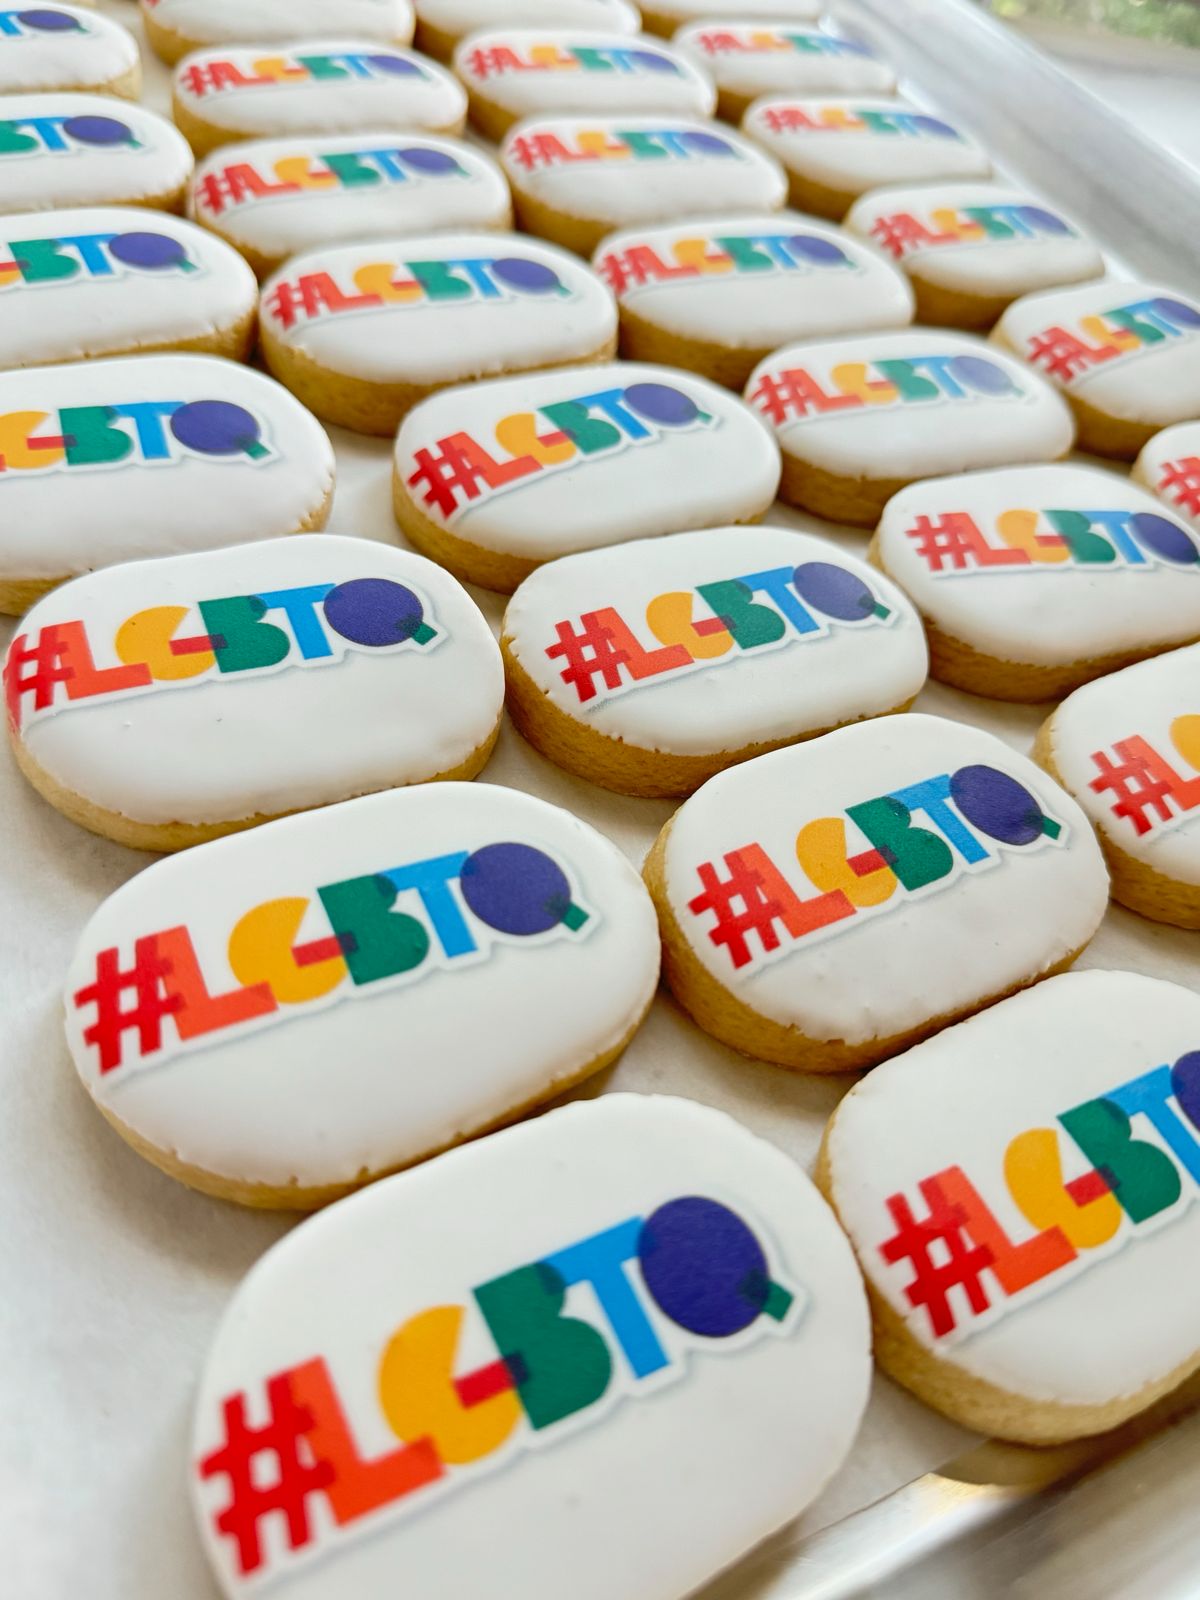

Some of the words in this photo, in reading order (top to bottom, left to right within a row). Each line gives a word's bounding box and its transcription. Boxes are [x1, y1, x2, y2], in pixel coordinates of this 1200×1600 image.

[181, 54, 428, 97] #LGBTQ
[197, 147, 468, 214] #LGBTQ
[267, 257, 571, 330] #LGBTQ
[594, 234, 856, 297] #LGBTQ
[752, 355, 1026, 427] #LGBTQ
[408, 383, 712, 520] #LGBTQ
[906, 509, 1200, 572] #LGBTQ
[3, 577, 438, 732] #LGBTQ
[545, 561, 891, 703] #LGBTQ
[689, 763, 1061, 970] #LGBTQ
[74, 841, 590, 1075] #LGBTQ
[199, 1195, 794, 1577] #LGBTQ
